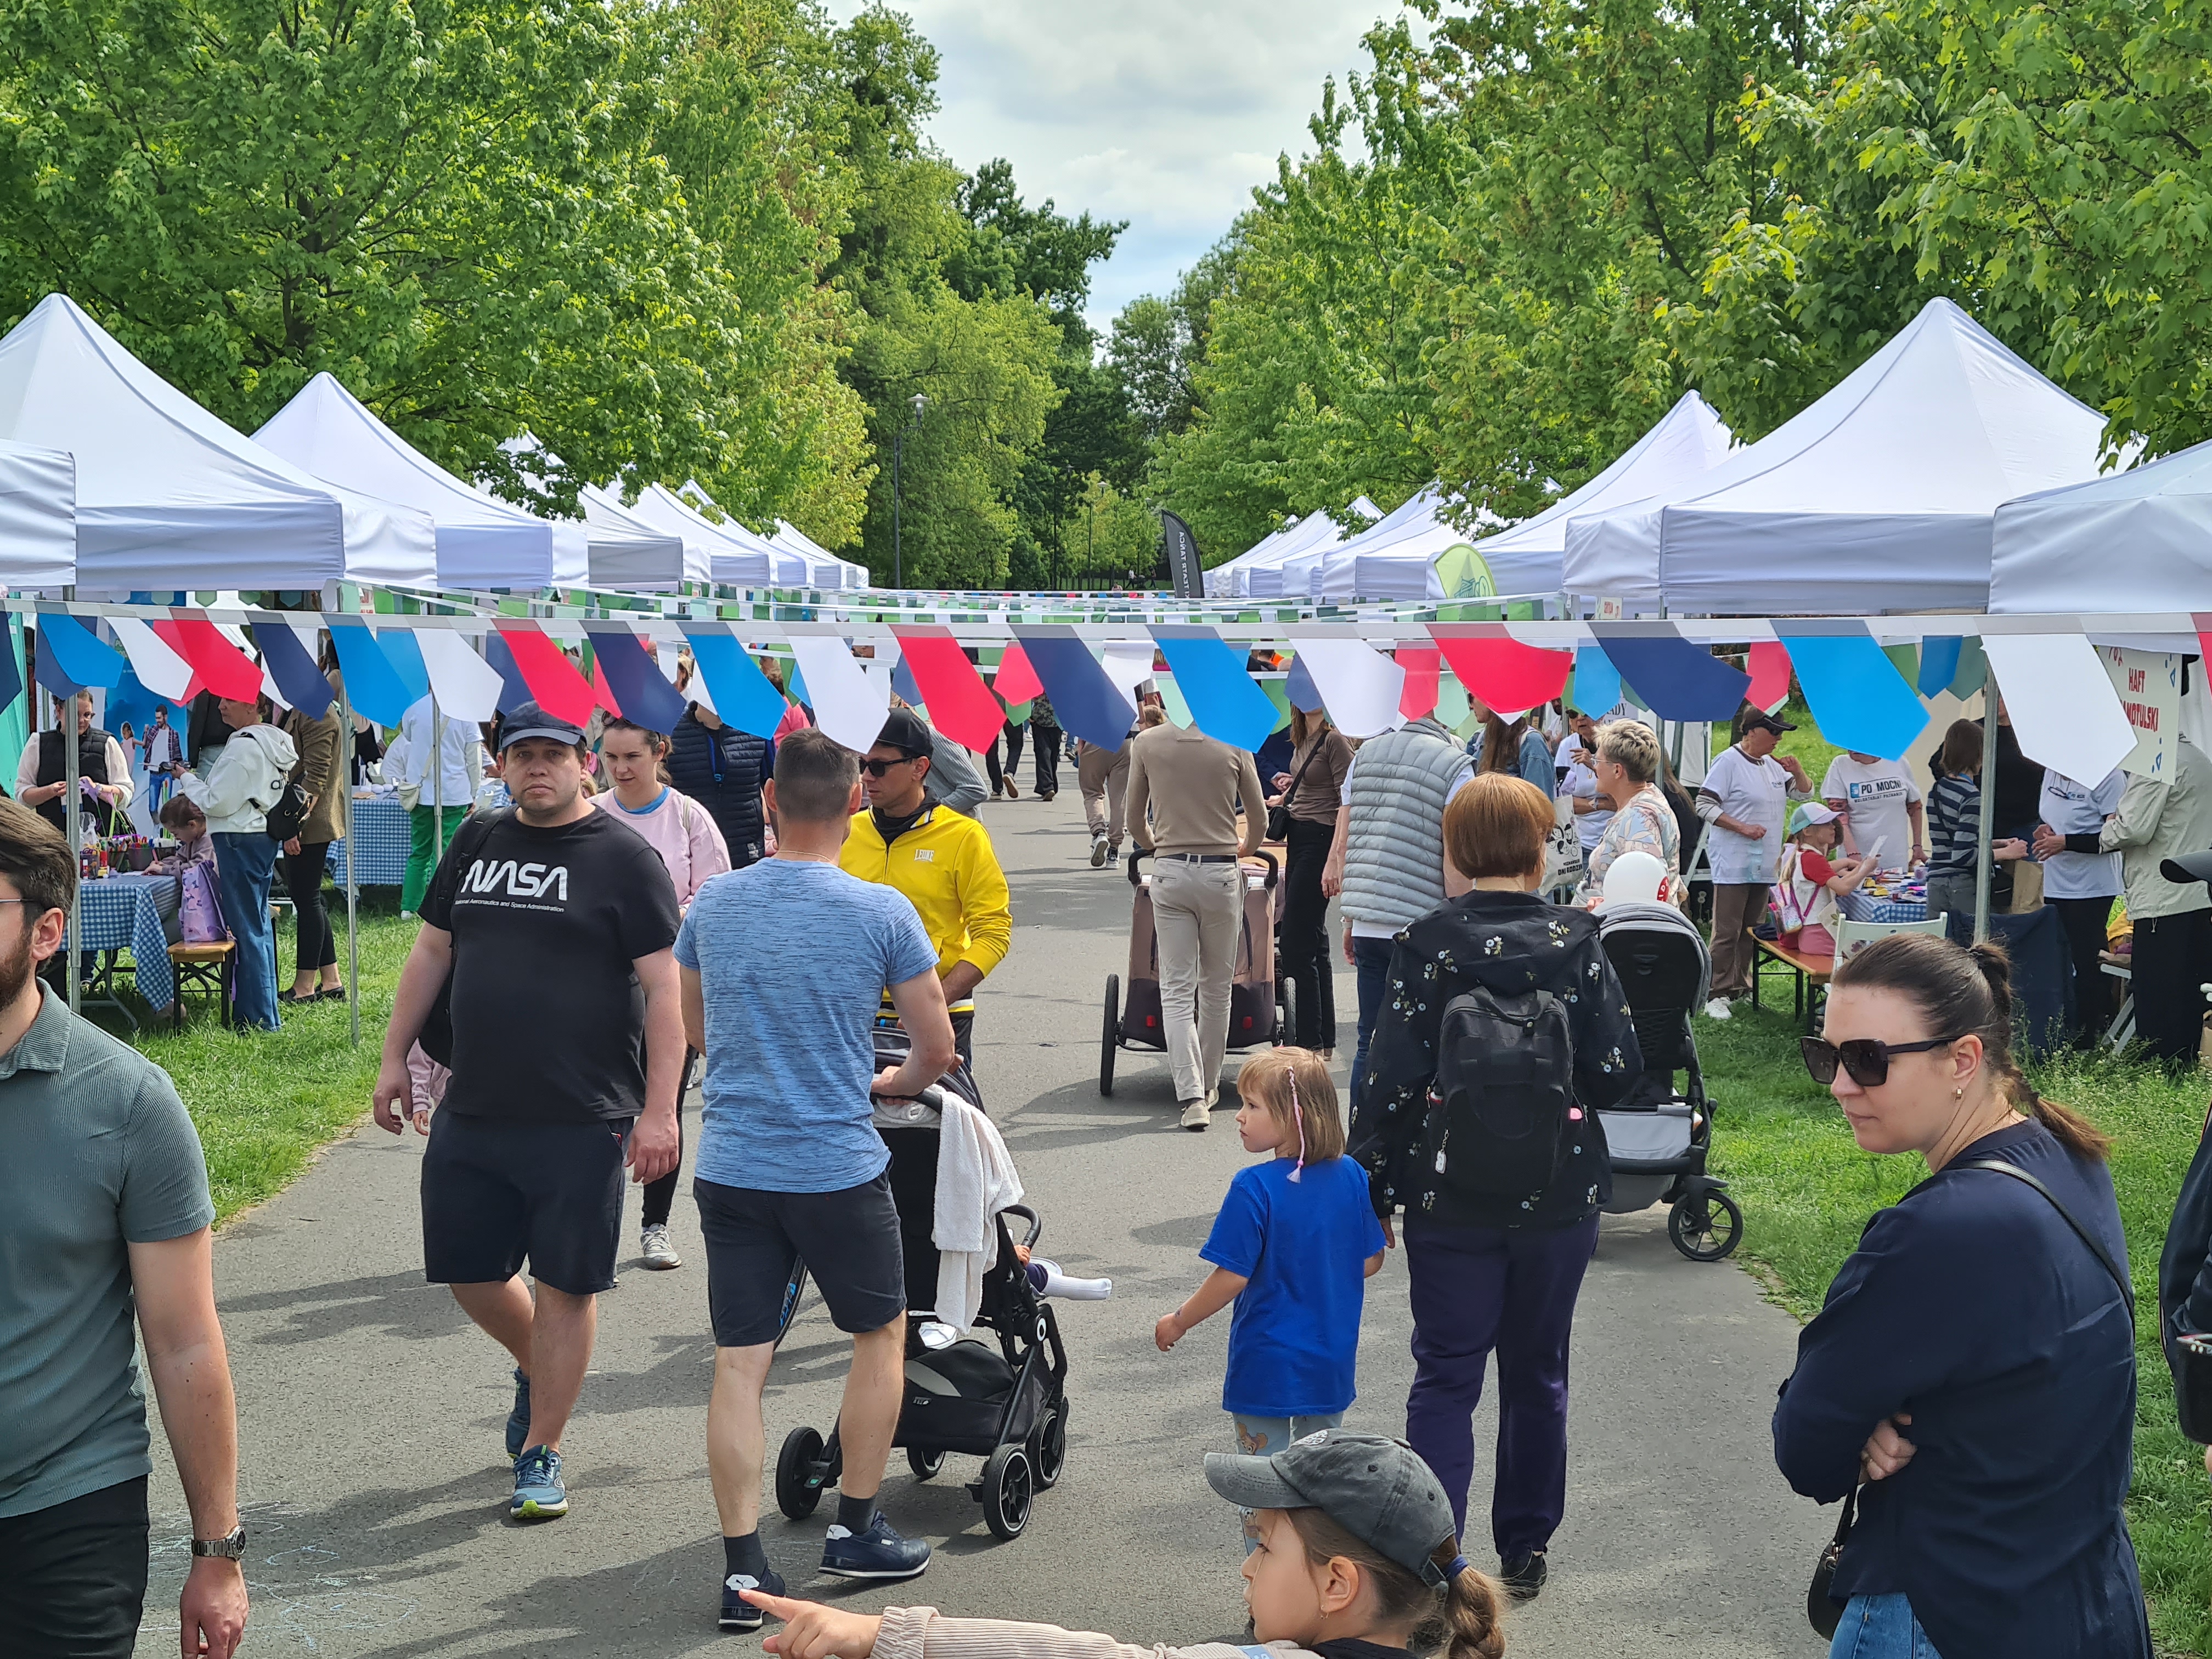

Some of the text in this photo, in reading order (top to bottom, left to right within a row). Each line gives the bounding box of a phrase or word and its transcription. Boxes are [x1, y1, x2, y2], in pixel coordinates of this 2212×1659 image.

[2128, 667, 2146, 693] HAFT
[1861, 783, 1872, 794] PO
[914, 849, 935, 862] LEONE
[460, 859, 568, 901] NASA
[527, 903, 565, 912] Administration
